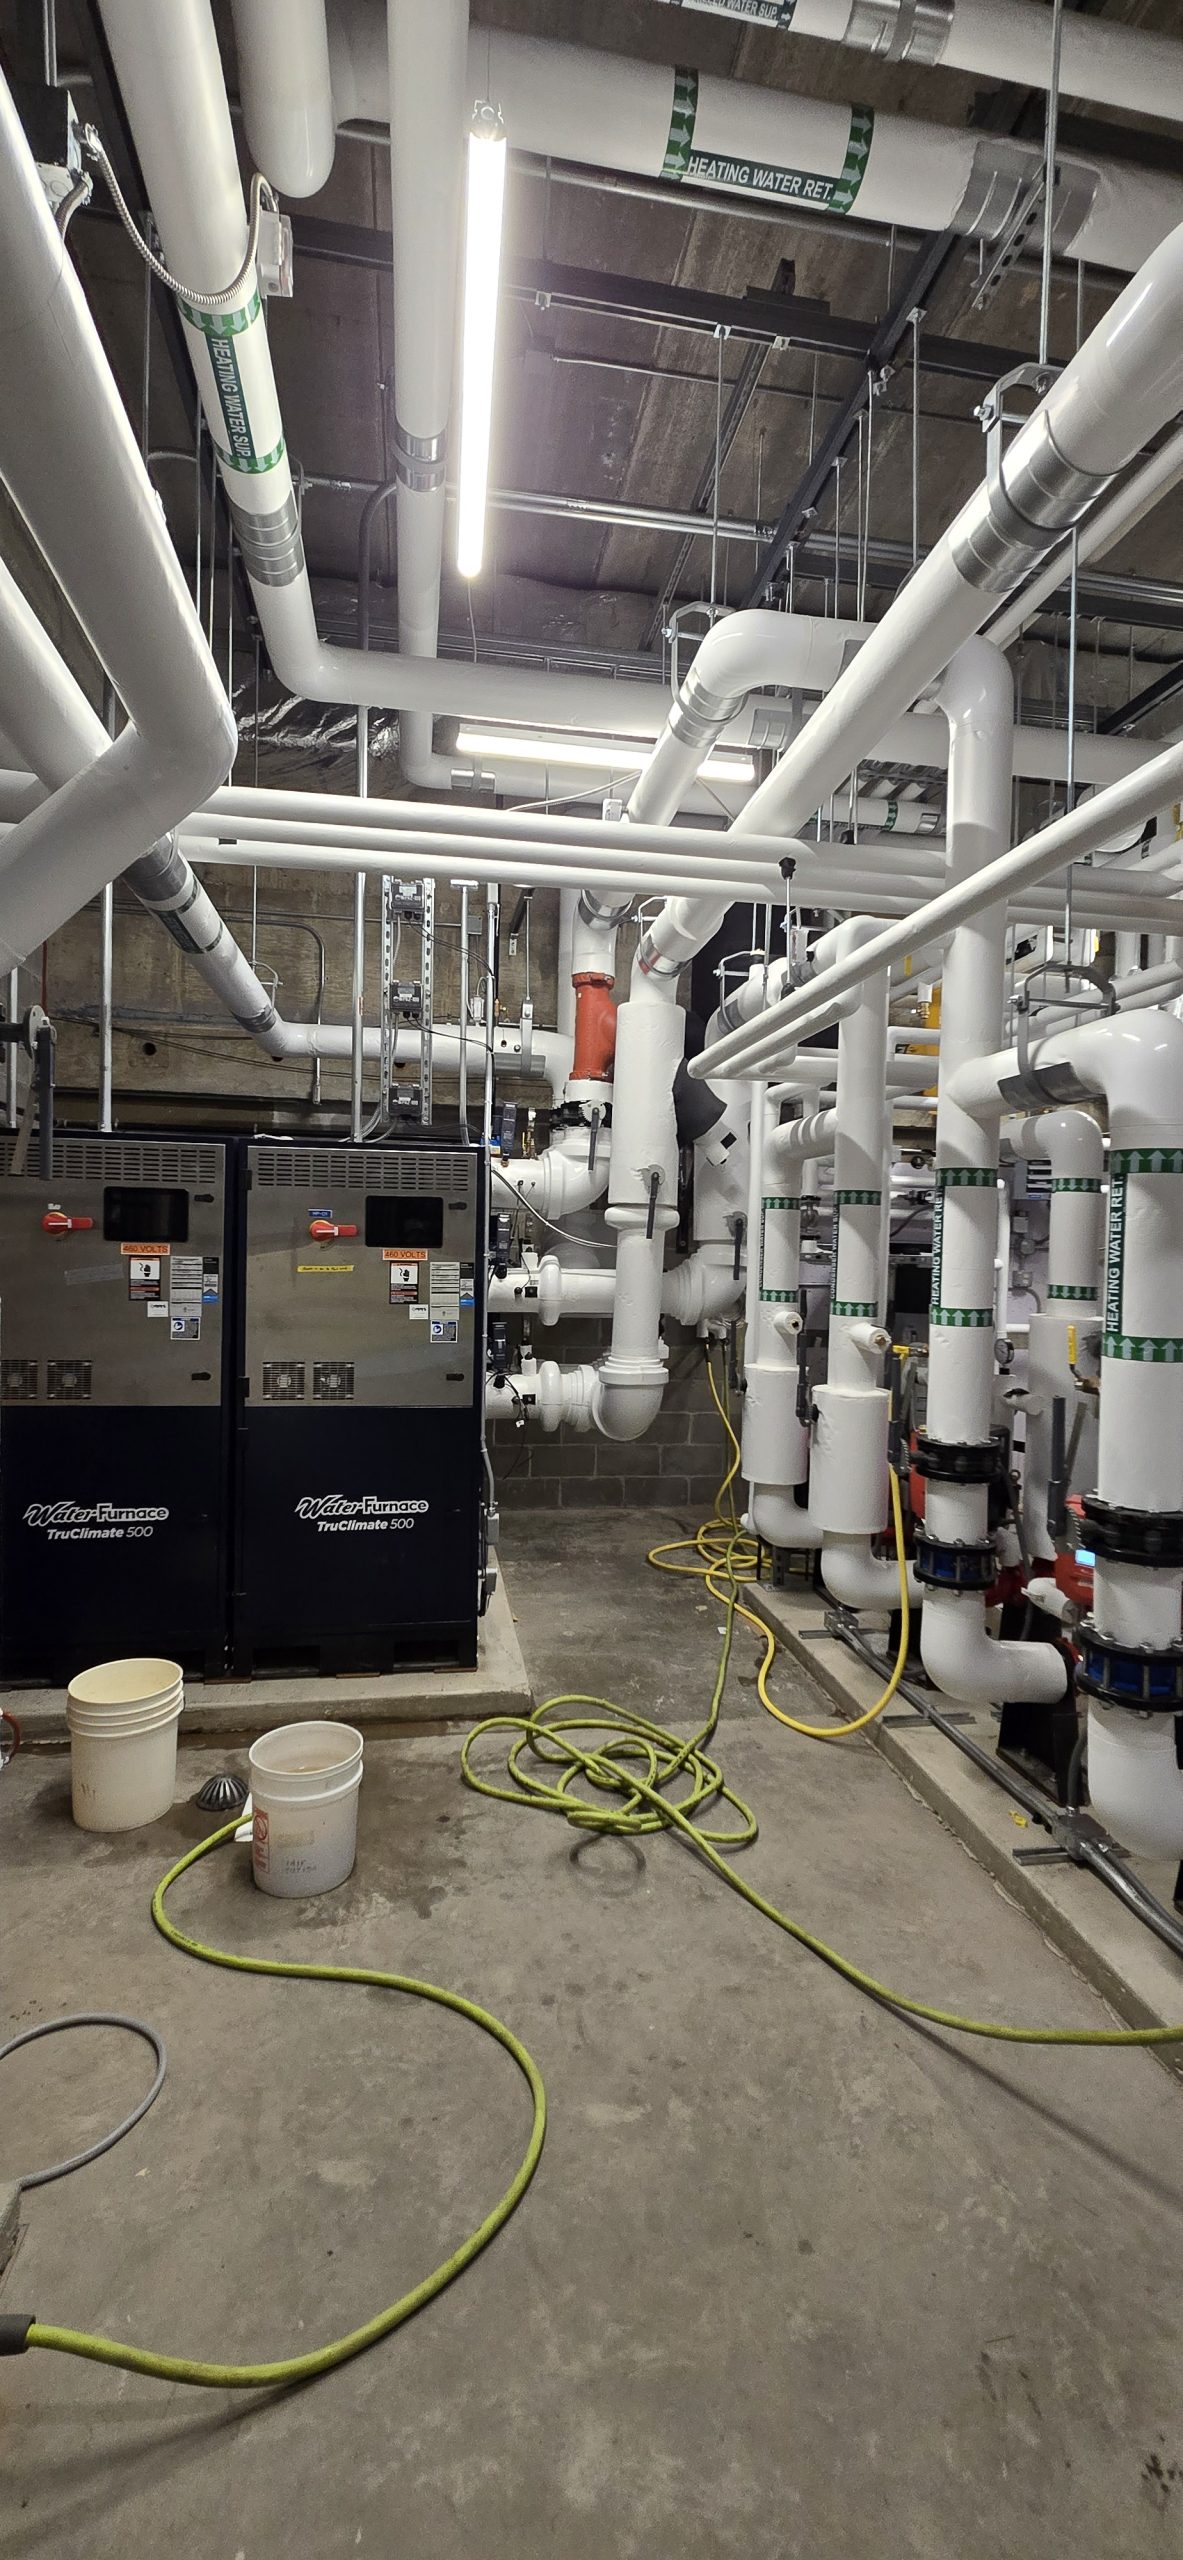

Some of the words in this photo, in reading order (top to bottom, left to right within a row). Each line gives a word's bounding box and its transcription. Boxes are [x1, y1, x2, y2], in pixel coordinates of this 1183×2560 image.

[726, 0, 758, 16] WATER
[758, 3, 778, 20] SUP.
[687, 156, 749, 184] HEATING
[752, 168, 802, 195] WATER
[803, 179, 834, 200] RET.
[211, 338, 237, 392] HEATING
[224, 395, 245, 433] WATER
[233, 435, 251, 457] SUP.
[1111, 1176, 1124, 1206] RET.
[140, 1245, 168, 1253] VOLTS
[932, 1215, 943, 1254] WATER
[1108, 1211, 1122, 1264] WATER
[931, 1255, 941, 1305] HEATING
[1106, 1267, 1120, 1332] HEATING
[22, 1501, 169, 1526] WaterFurnace
[294, 1495, 429, 1519] WaterFurnace
[47, 1528, 124, 1540] TruClimate
[125, 1526, 154, 1538] 500
[317, 1520, 388, 1532] TruClimate
[389, 1517, 415, 1529] 500
